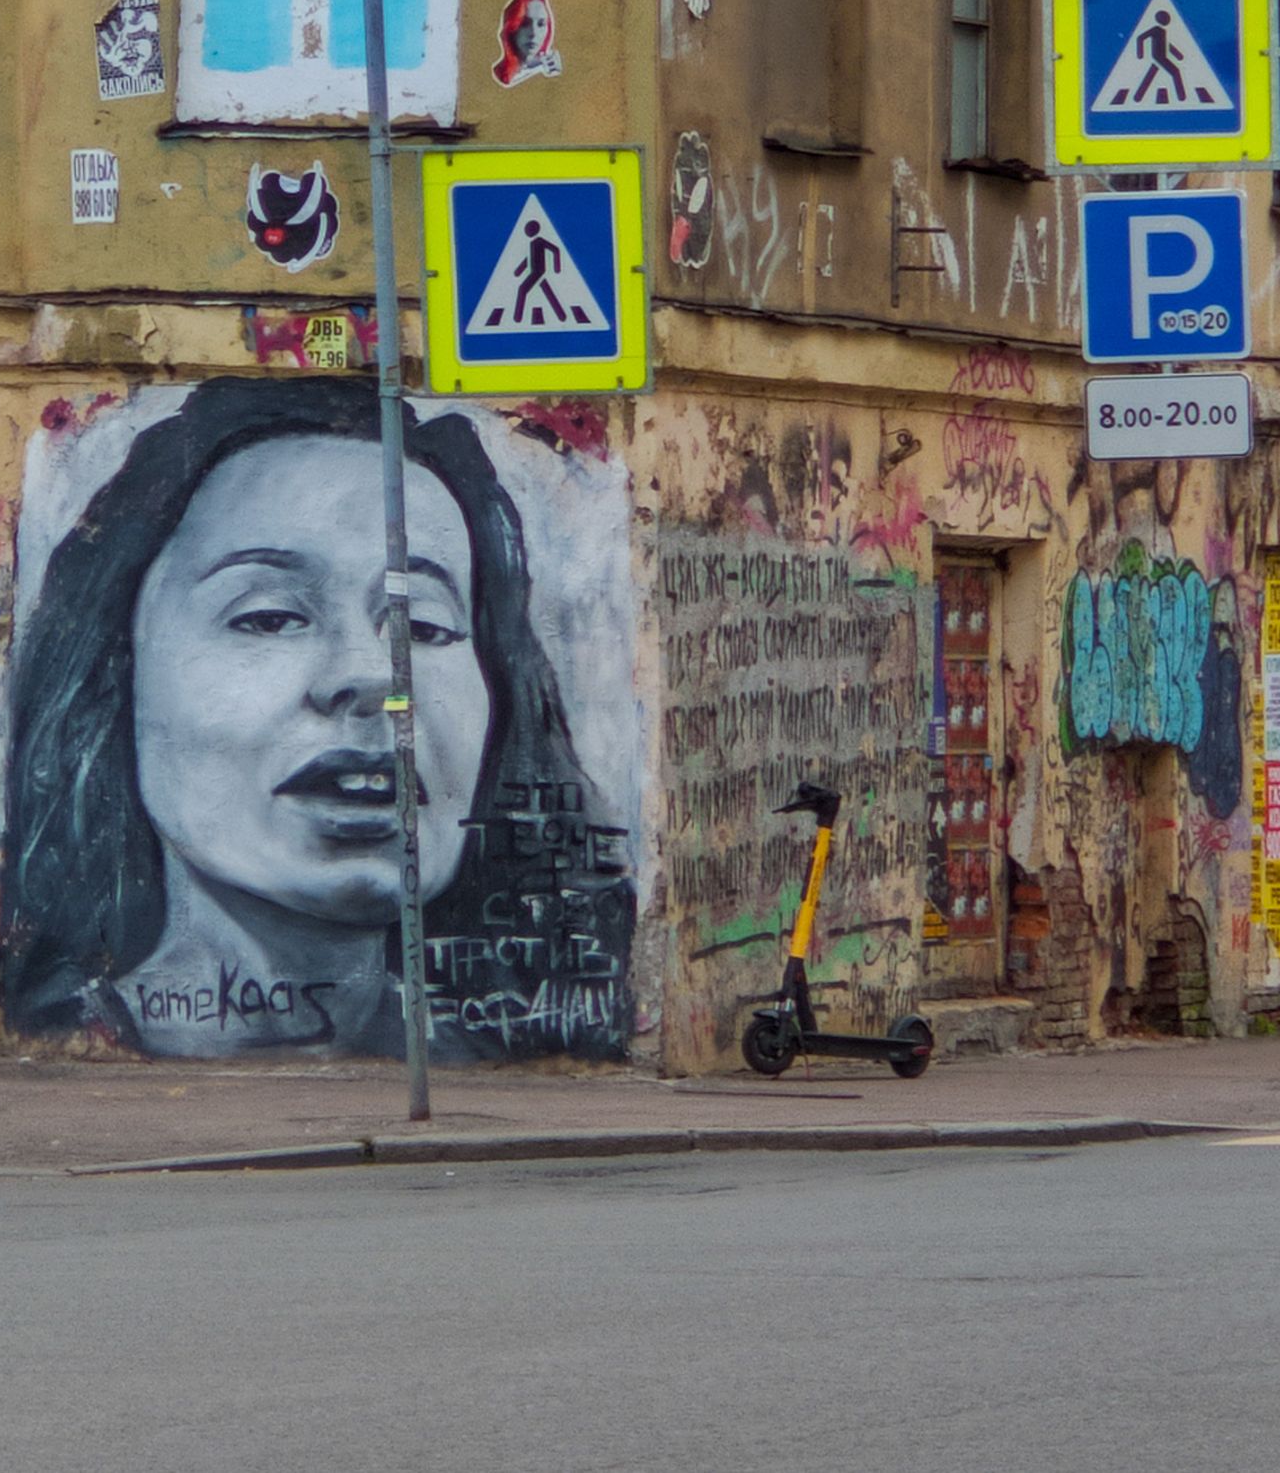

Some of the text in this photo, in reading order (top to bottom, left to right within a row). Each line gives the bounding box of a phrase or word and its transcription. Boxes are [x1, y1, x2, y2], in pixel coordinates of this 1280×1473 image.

[74, 153, 117, 183] ОТДЫХ
[1129, 214, 1214, 339] P
[1163, 311, 1228, 330] 10 15 20
[1099, 402, 1238, 429] 8.00-20.00
